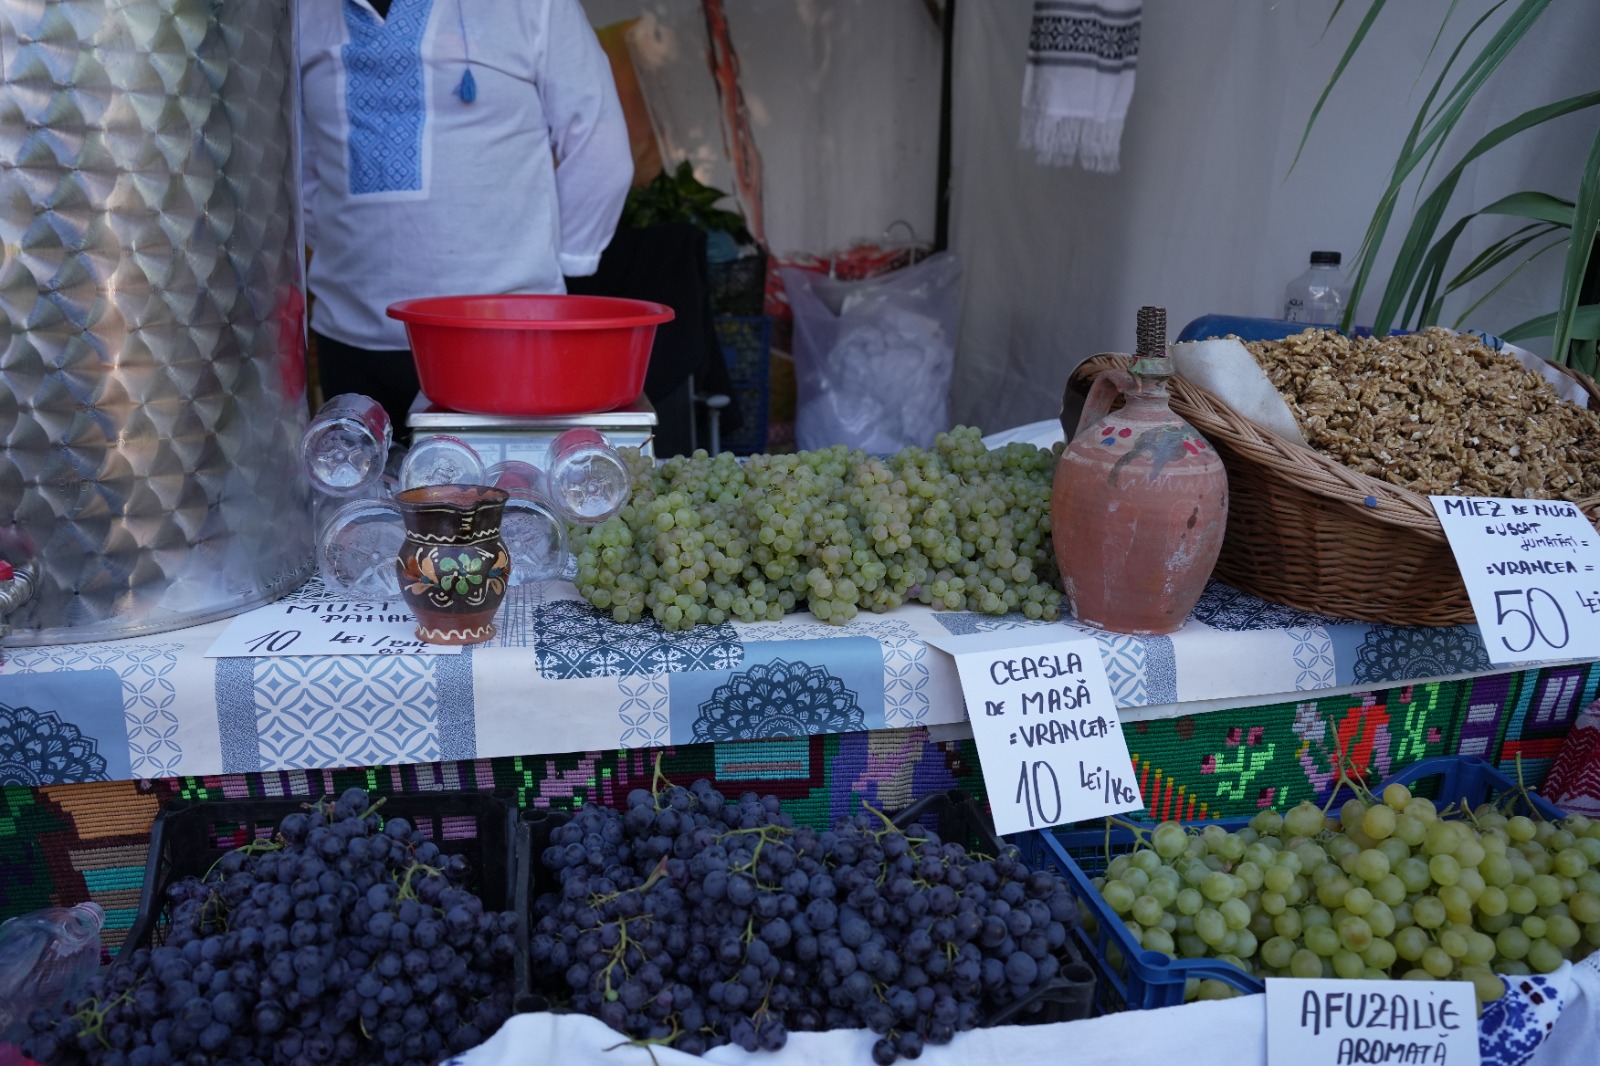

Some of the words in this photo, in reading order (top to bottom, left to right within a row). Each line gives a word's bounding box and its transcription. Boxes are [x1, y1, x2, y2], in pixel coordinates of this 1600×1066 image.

[1511, 504, 1529, 516] DE
[286, 602, 395, 614] MUST
[1494, 587, 1570, 653] 50
[244, 630, 301, 653] 10
[990, 652, 1083, 685] CEASLA
[985, 701, 1006, 716] DE
[1021, 679, 1092, 716] MASĂ
[1015, 760, 1062, 828] 10
[1337, 1033, 1449, 1066] AROMATĂ
